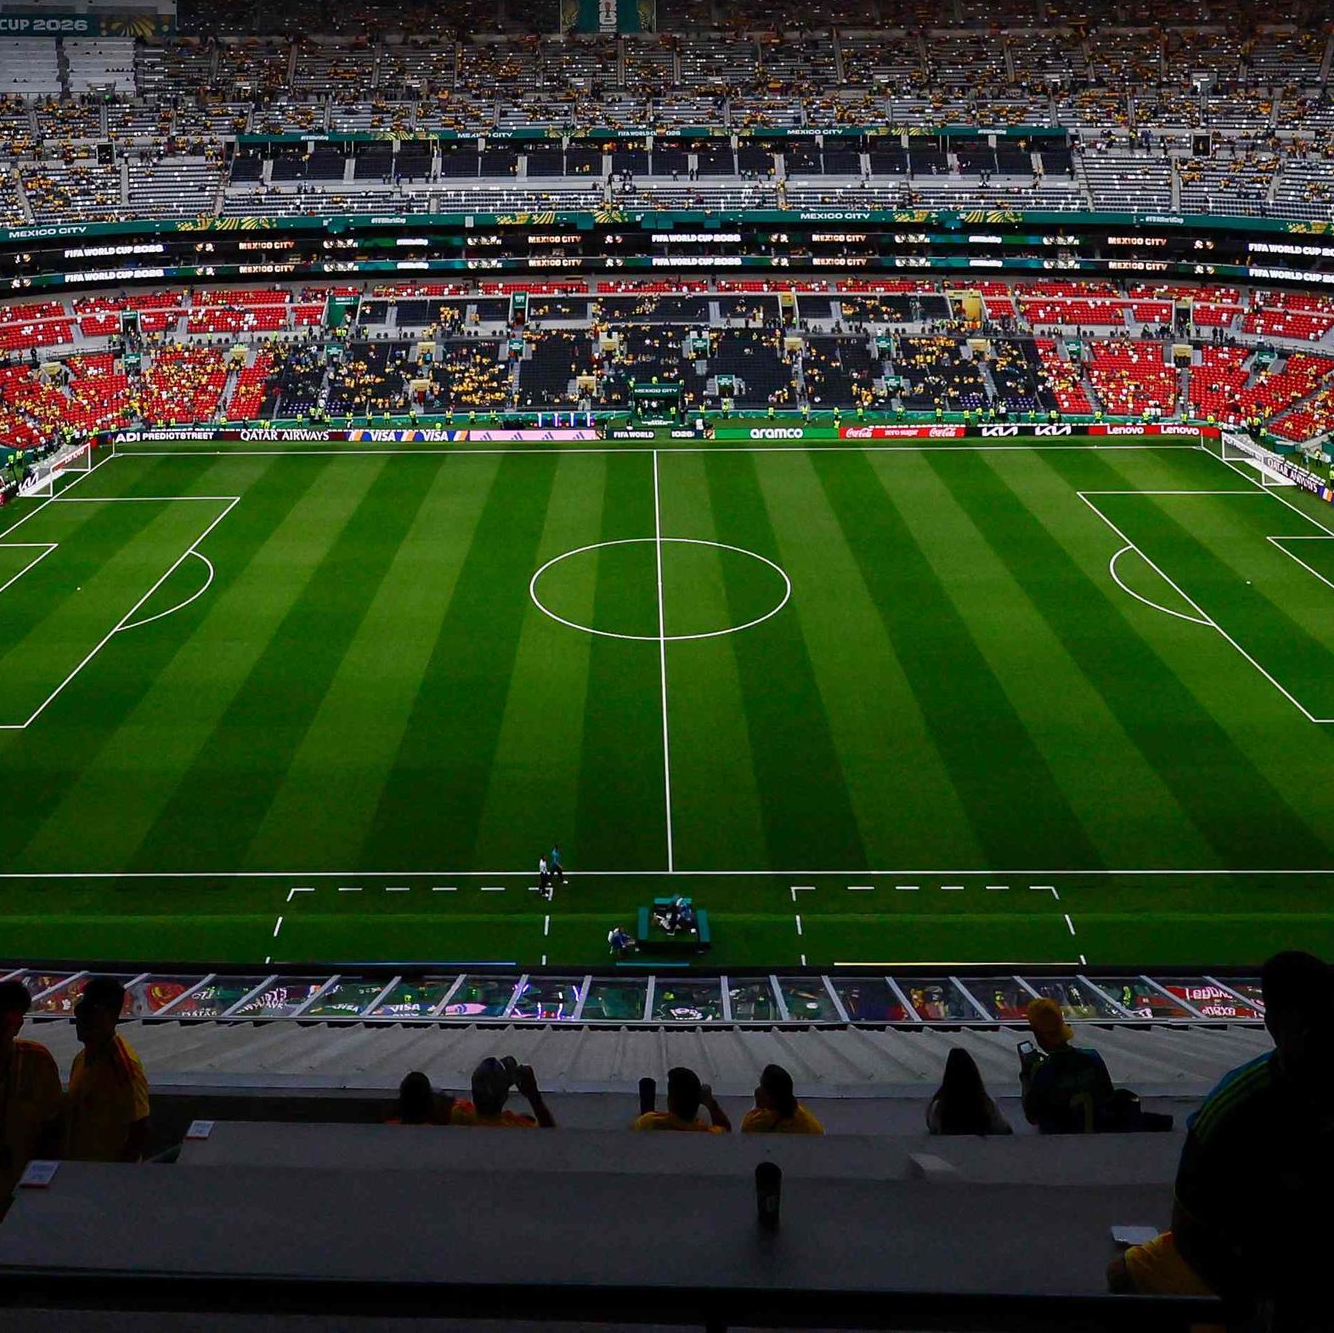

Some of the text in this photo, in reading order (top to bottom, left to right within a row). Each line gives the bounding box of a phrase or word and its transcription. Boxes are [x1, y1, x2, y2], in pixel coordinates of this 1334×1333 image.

[32, 19, 88, 32] 2026
[800, 212, 871, 220] MEXICO CITY
[8, 225, 87, 238] MEXICO CITY
[812, 234, 845, 242] MEXICO
[1107, 237, 1167, 246] MEXICO CITY
[239, 241, 295, 250] MEXICO CITY
[1248, 243, 1269, 252] FIFA
[1269, 244, 1302, 254] WORLD
[1303, 246, 1322, 255] CUP
[64, 249, 84, 258] FIFA
[84, 248, 115, 257] WORLD
[116, 246, 133, 254] CUP
[812, 258, 867, 266] MEXICO CITY
[1108, 261, 1168, 271] MEXICO CITY
[239, 265, 295, 274] MEXICO CITY
[1249, 268, 1269, 277] FIFA
[1269, 270, 1303, 280] WORLD
[1303, 272, 1322, 282] CUP
[64, 274, 84, 282] FIFA
[84, 272, 115, 281] WORLD
[116, 271, 133, 279] CUP
[240, 429, 329, 442] QATAR AIRWAYS
[371, 430, 449, 441] VISA VISA
[750, 427, 803, 439] aramco
[1107, 425, 1200, 436] Lenovo Lenovo
[116, 431, 140, 443] ADI
